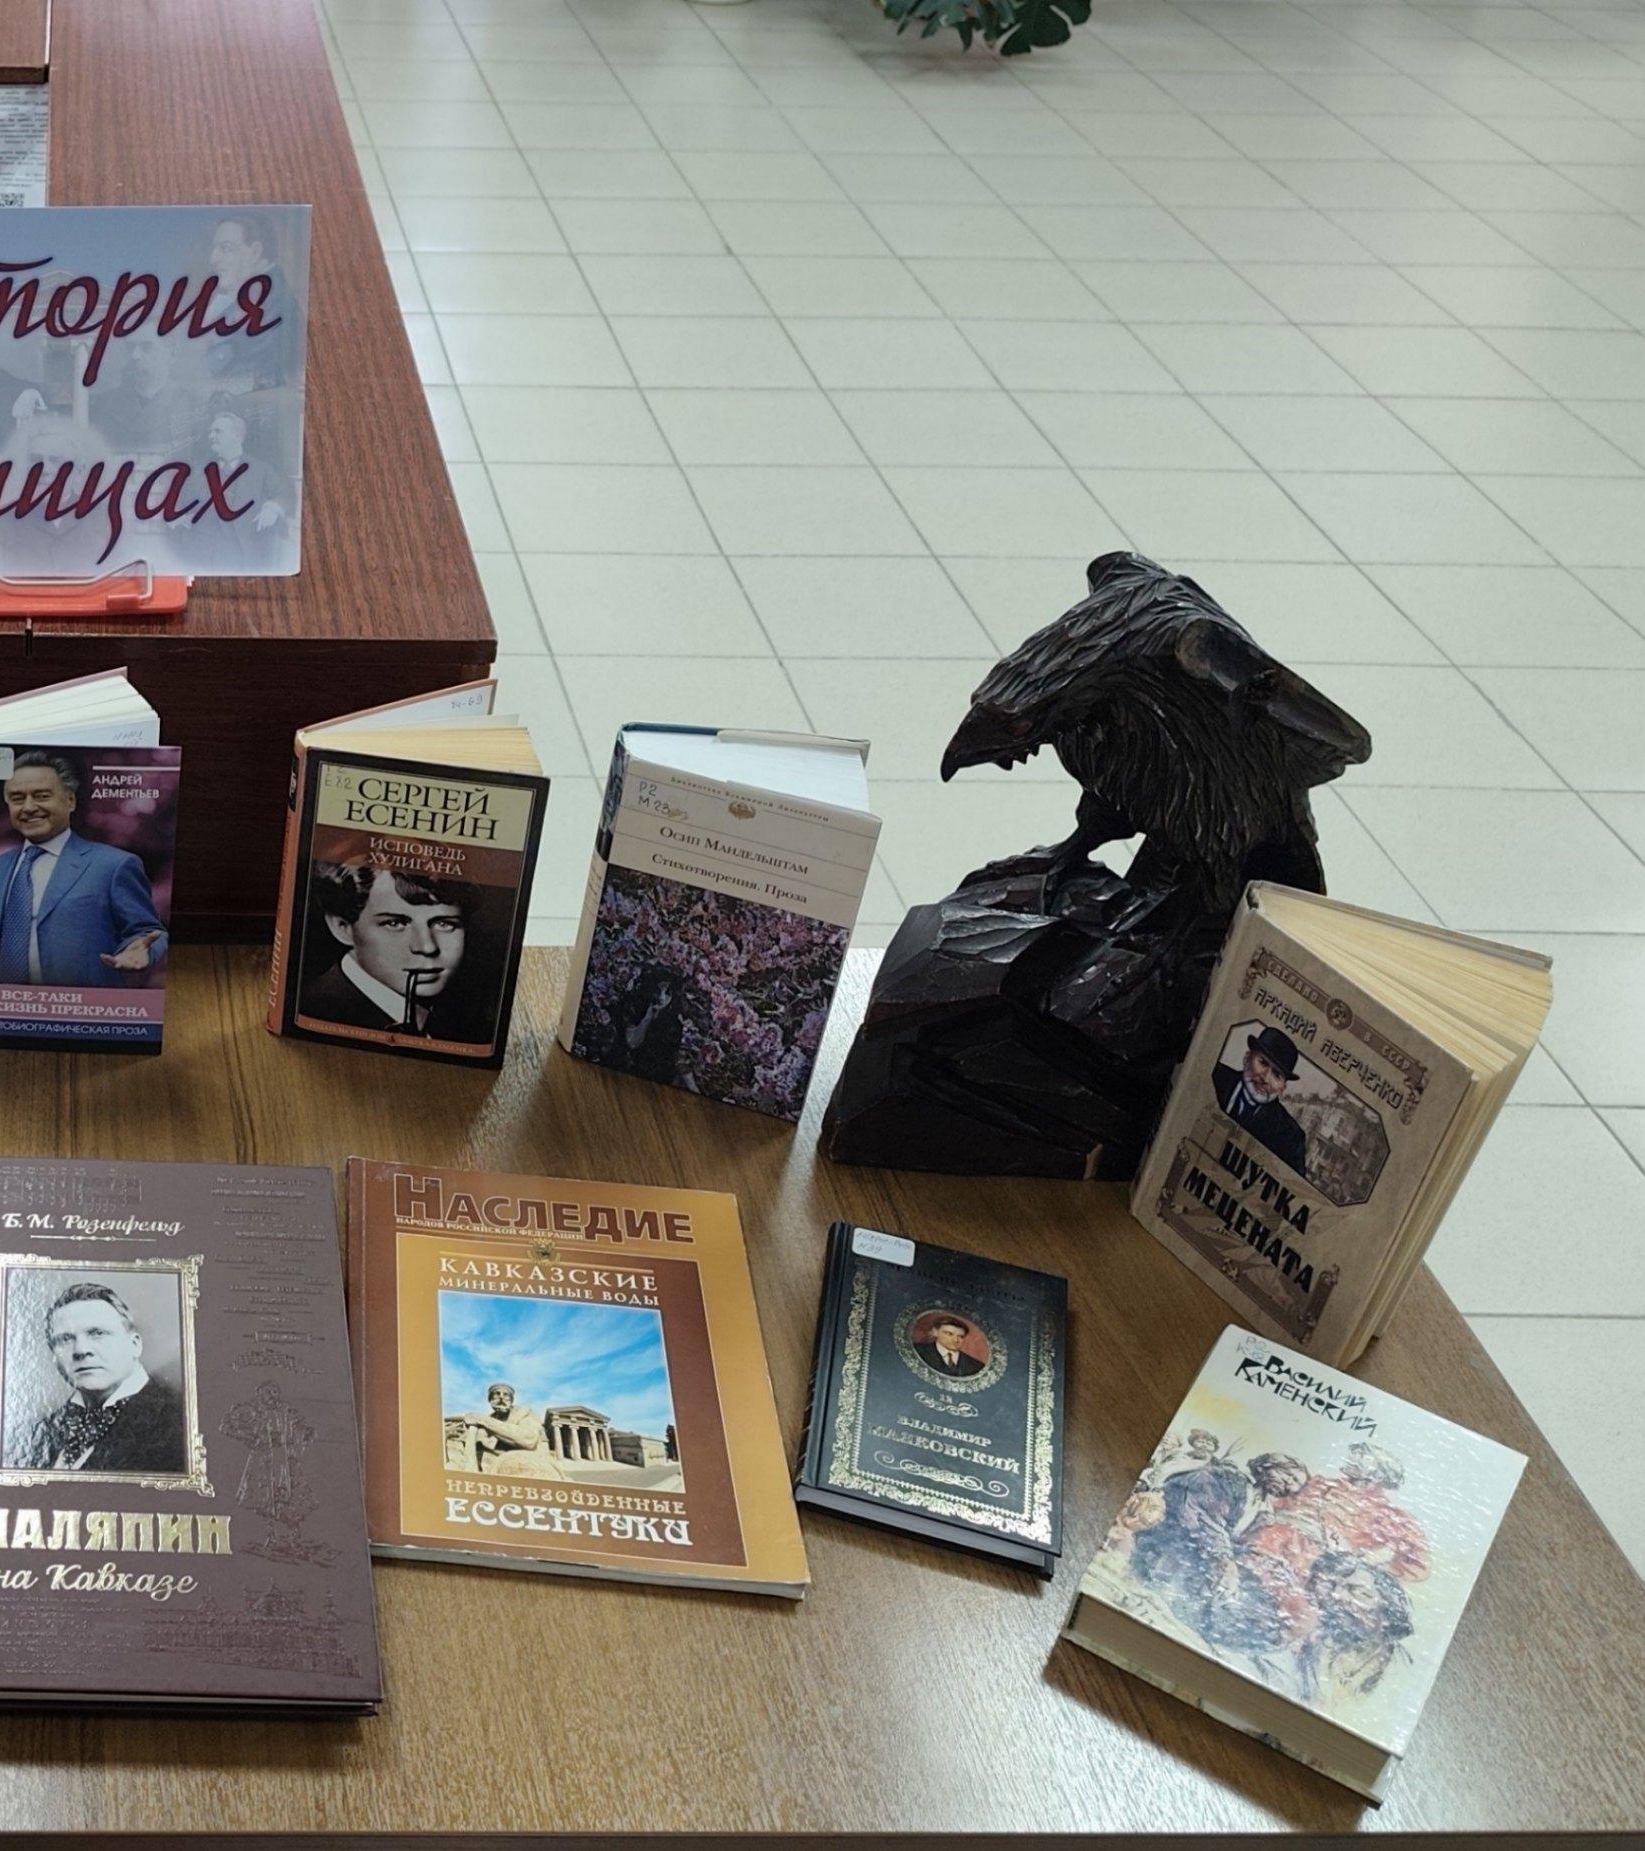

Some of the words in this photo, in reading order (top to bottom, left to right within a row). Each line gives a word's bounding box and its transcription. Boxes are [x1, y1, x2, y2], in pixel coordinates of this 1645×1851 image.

[91, 787, 160, 800] ДЕМЕНТЬЕВ
[92, 773, 143, 786] АНДРЕЙ
[358, 777, 491, 815] СЕРГЕЙ
[344, 800, 500, 840] ЕСЕНИН
[368, 852, 463, 877] ХУЛИГАНА
[370, 837, 466, 862] ИСПОВЕДЬ
[764, 883, 808, 904] Проза
[1, 990, 83, 1003] ВСЕ-ТАКИ
[50, 1003, 148, 1018] ПРЕКРАСНА
[112, 1025, 148, 1036] ПРОЗА
[1254, 987, 1318, 1042] АРКАДИЙ
[1320, 1040, 1404, 1110] АВЕРЧЕНКО
[1220, 1139, 1311, 1235] ШУТКА
[2, 1212, 23, 1229] Б.
[28, 1215, 54, 1230] М.
[63, 1213, 186, 1236] Розенфельд
[396, 1218, 444, 1229] НАРОДОВ
[447, 1222, 517, 1237] РОССИЙСКОЙ
[519, 1229, 584, 1241] ФЕДЕРАЦИИ
[1182, 1166, 1315, 1293] МЕЦЕНАТА
[440, 1257, 658, 1292] КАВКАЗСКИЕ
[440, 1276, 594, 1300] МИНЕРАЛЬНЫЕ
[603, 1290, 660, 1307] ВОДЫ
[897, 1414, 992, 1447] ВЛАДИМИР
[866, 1422, 1021, 1475] МАЯКОВСКИЙ
[446, 1479, 687, 1515] НЕПРЕВЗОЙДЕННЫЕ
[445, 1497, 693, 1547] ЕССЕНТУКИ
[46, 1563, 198, 1600] Кавказе
